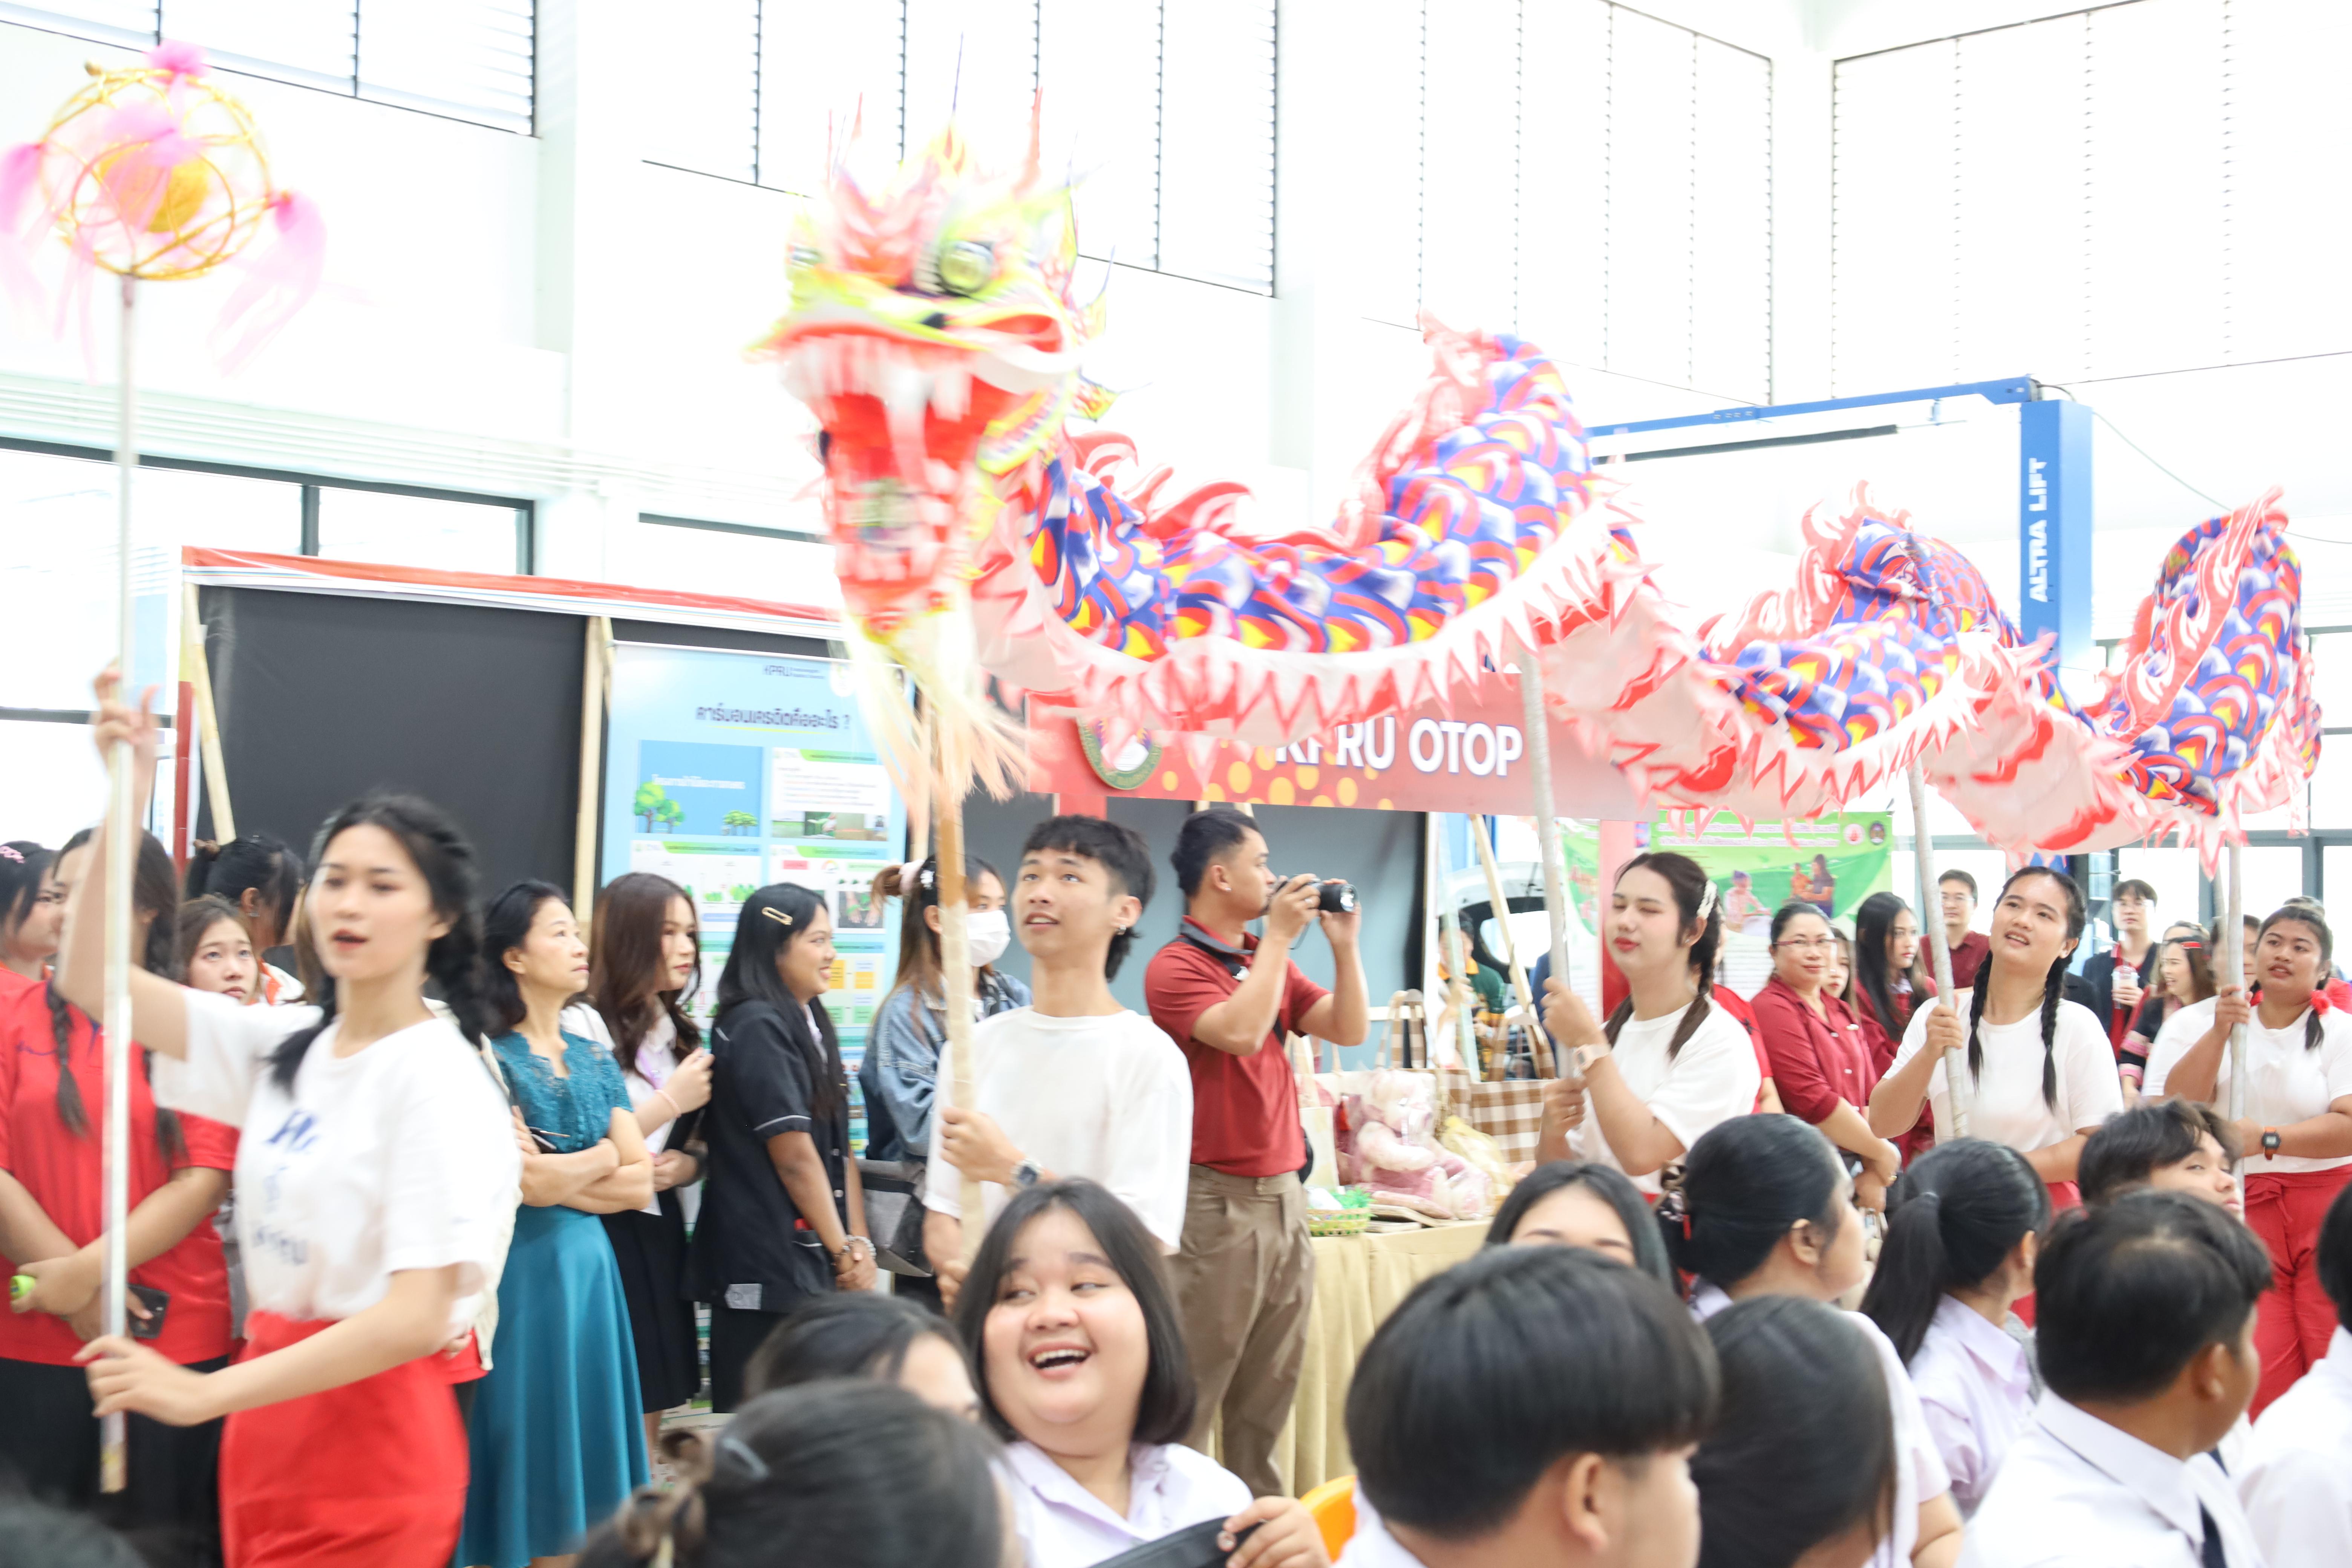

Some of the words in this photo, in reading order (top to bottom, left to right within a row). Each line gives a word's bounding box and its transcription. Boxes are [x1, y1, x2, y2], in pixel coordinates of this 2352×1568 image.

[2028, 458, 2047, 511] LIFT
[2028, 519, 2049, 602] ALTRA
[1408, 718, 1524, 776] OTOP
